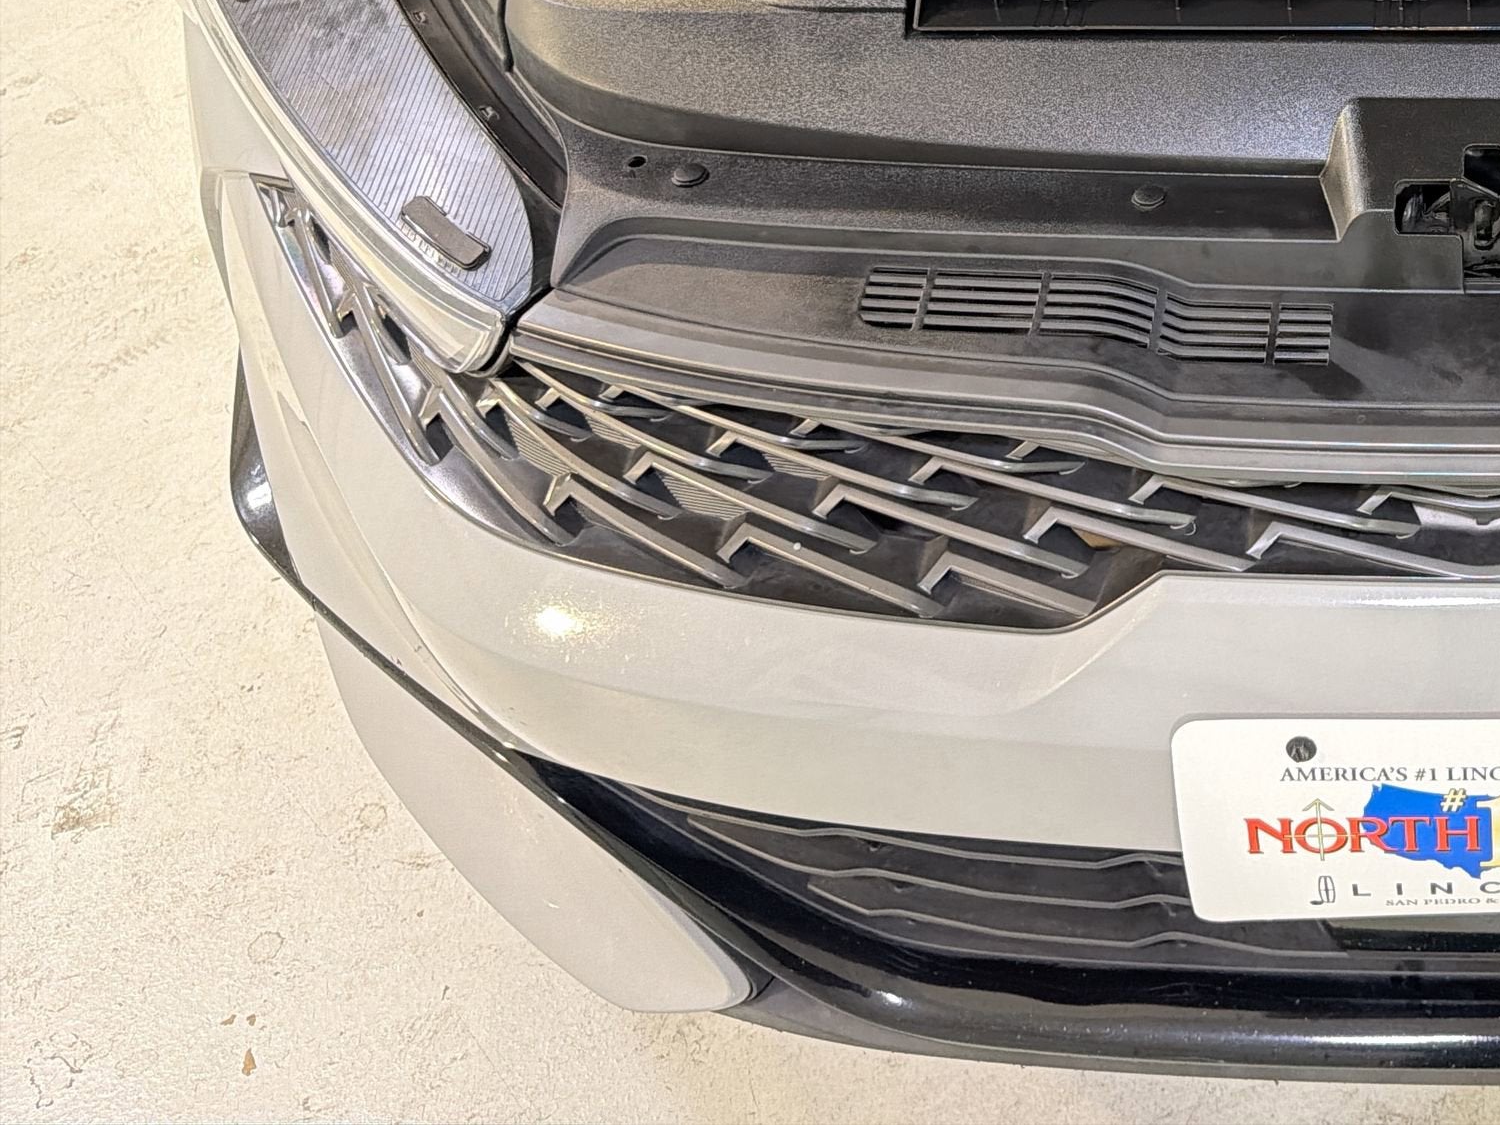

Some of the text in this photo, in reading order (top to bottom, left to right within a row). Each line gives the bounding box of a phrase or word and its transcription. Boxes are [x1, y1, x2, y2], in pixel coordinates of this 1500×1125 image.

[1280, 766, 1408, 782] AMERICA'S
[1414, 767, 1438, 782] #1
[1244, 817, 1482, 854] NORTH
[1424, 897, 1481, 905] PEDRO
